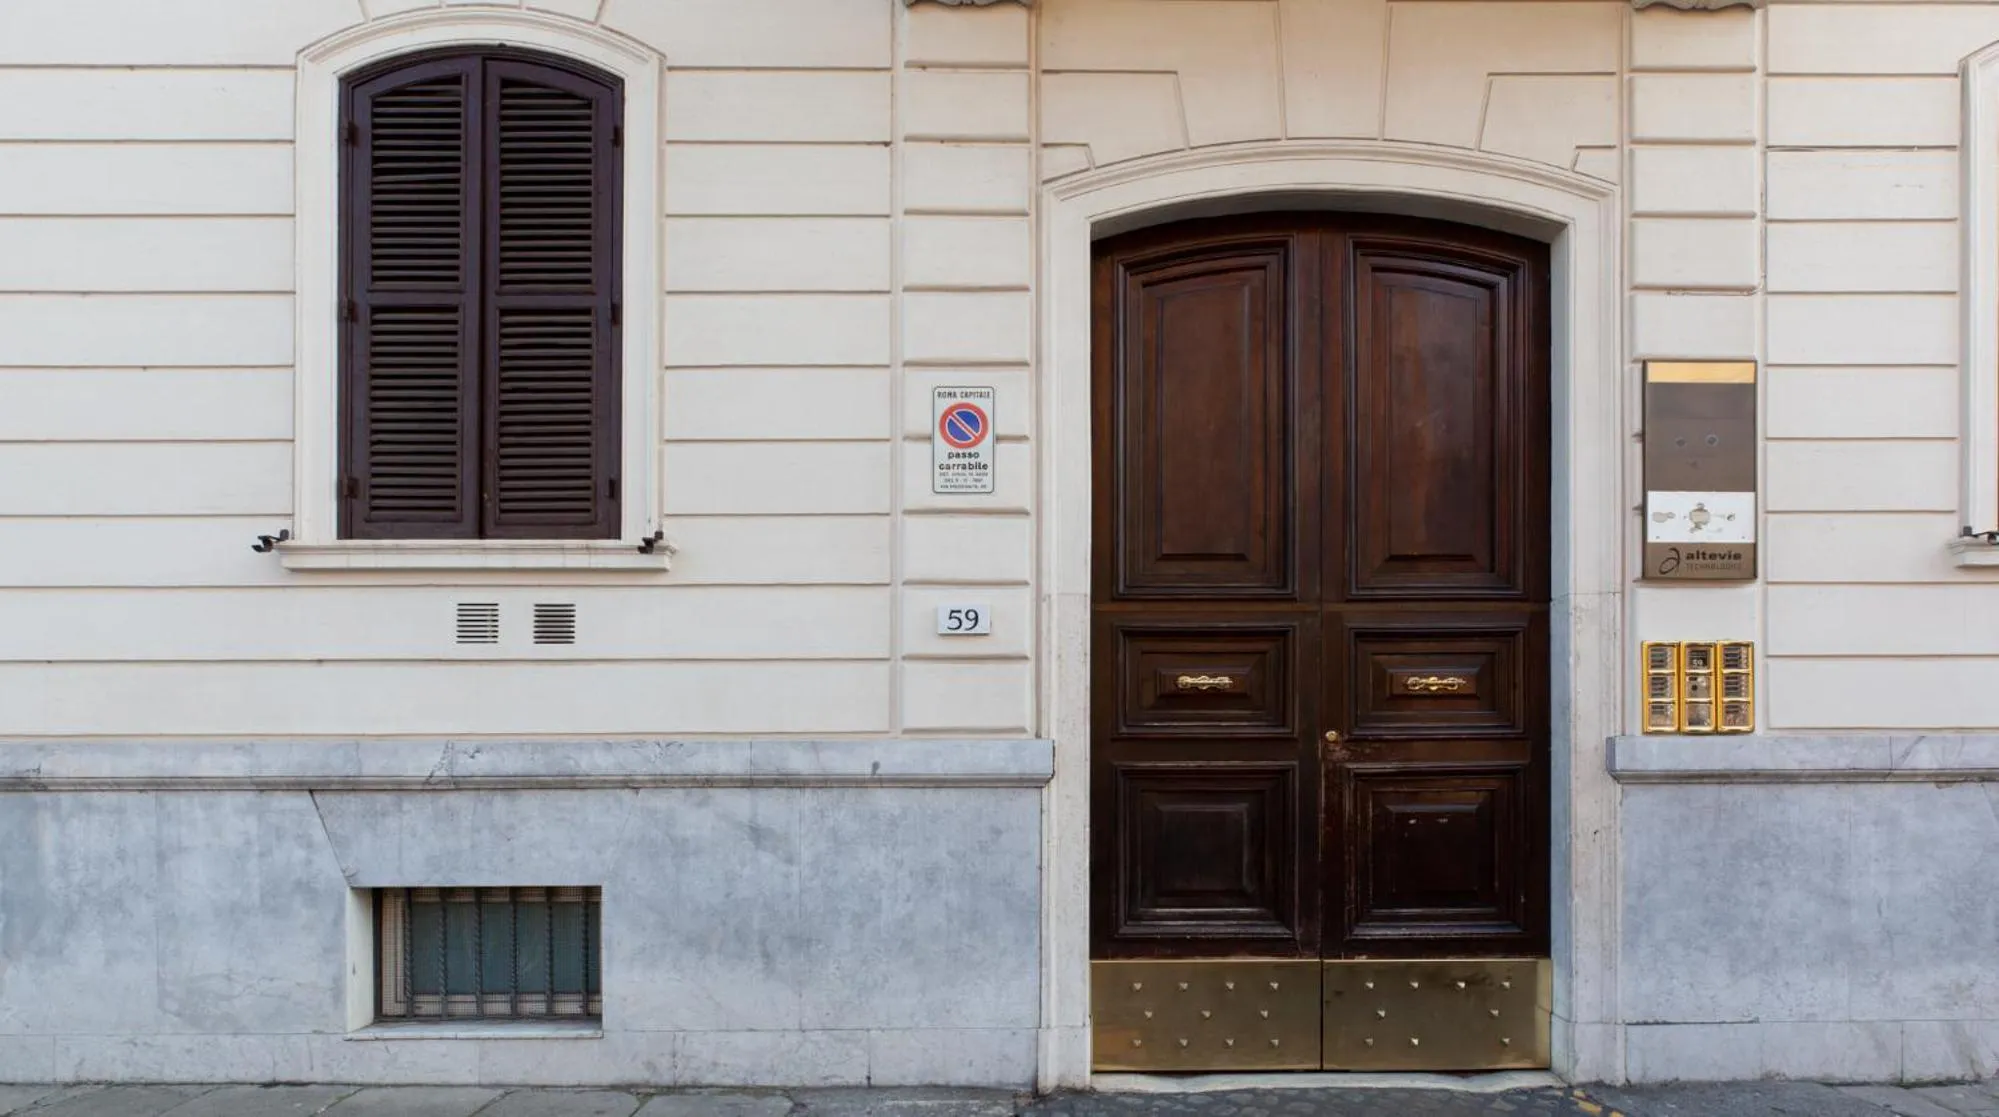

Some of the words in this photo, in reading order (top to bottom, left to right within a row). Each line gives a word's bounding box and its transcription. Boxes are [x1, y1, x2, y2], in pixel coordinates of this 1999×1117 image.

[937, 391, 957, 399] ROMA
[960, 391, 990, 399] CAPITALE
[947, 451, 980, 460] passo
[938, 462, 989, 471] carrabile
[1685, 549, 1742, 561] altevie
[947, 609, 979, 631] 59
